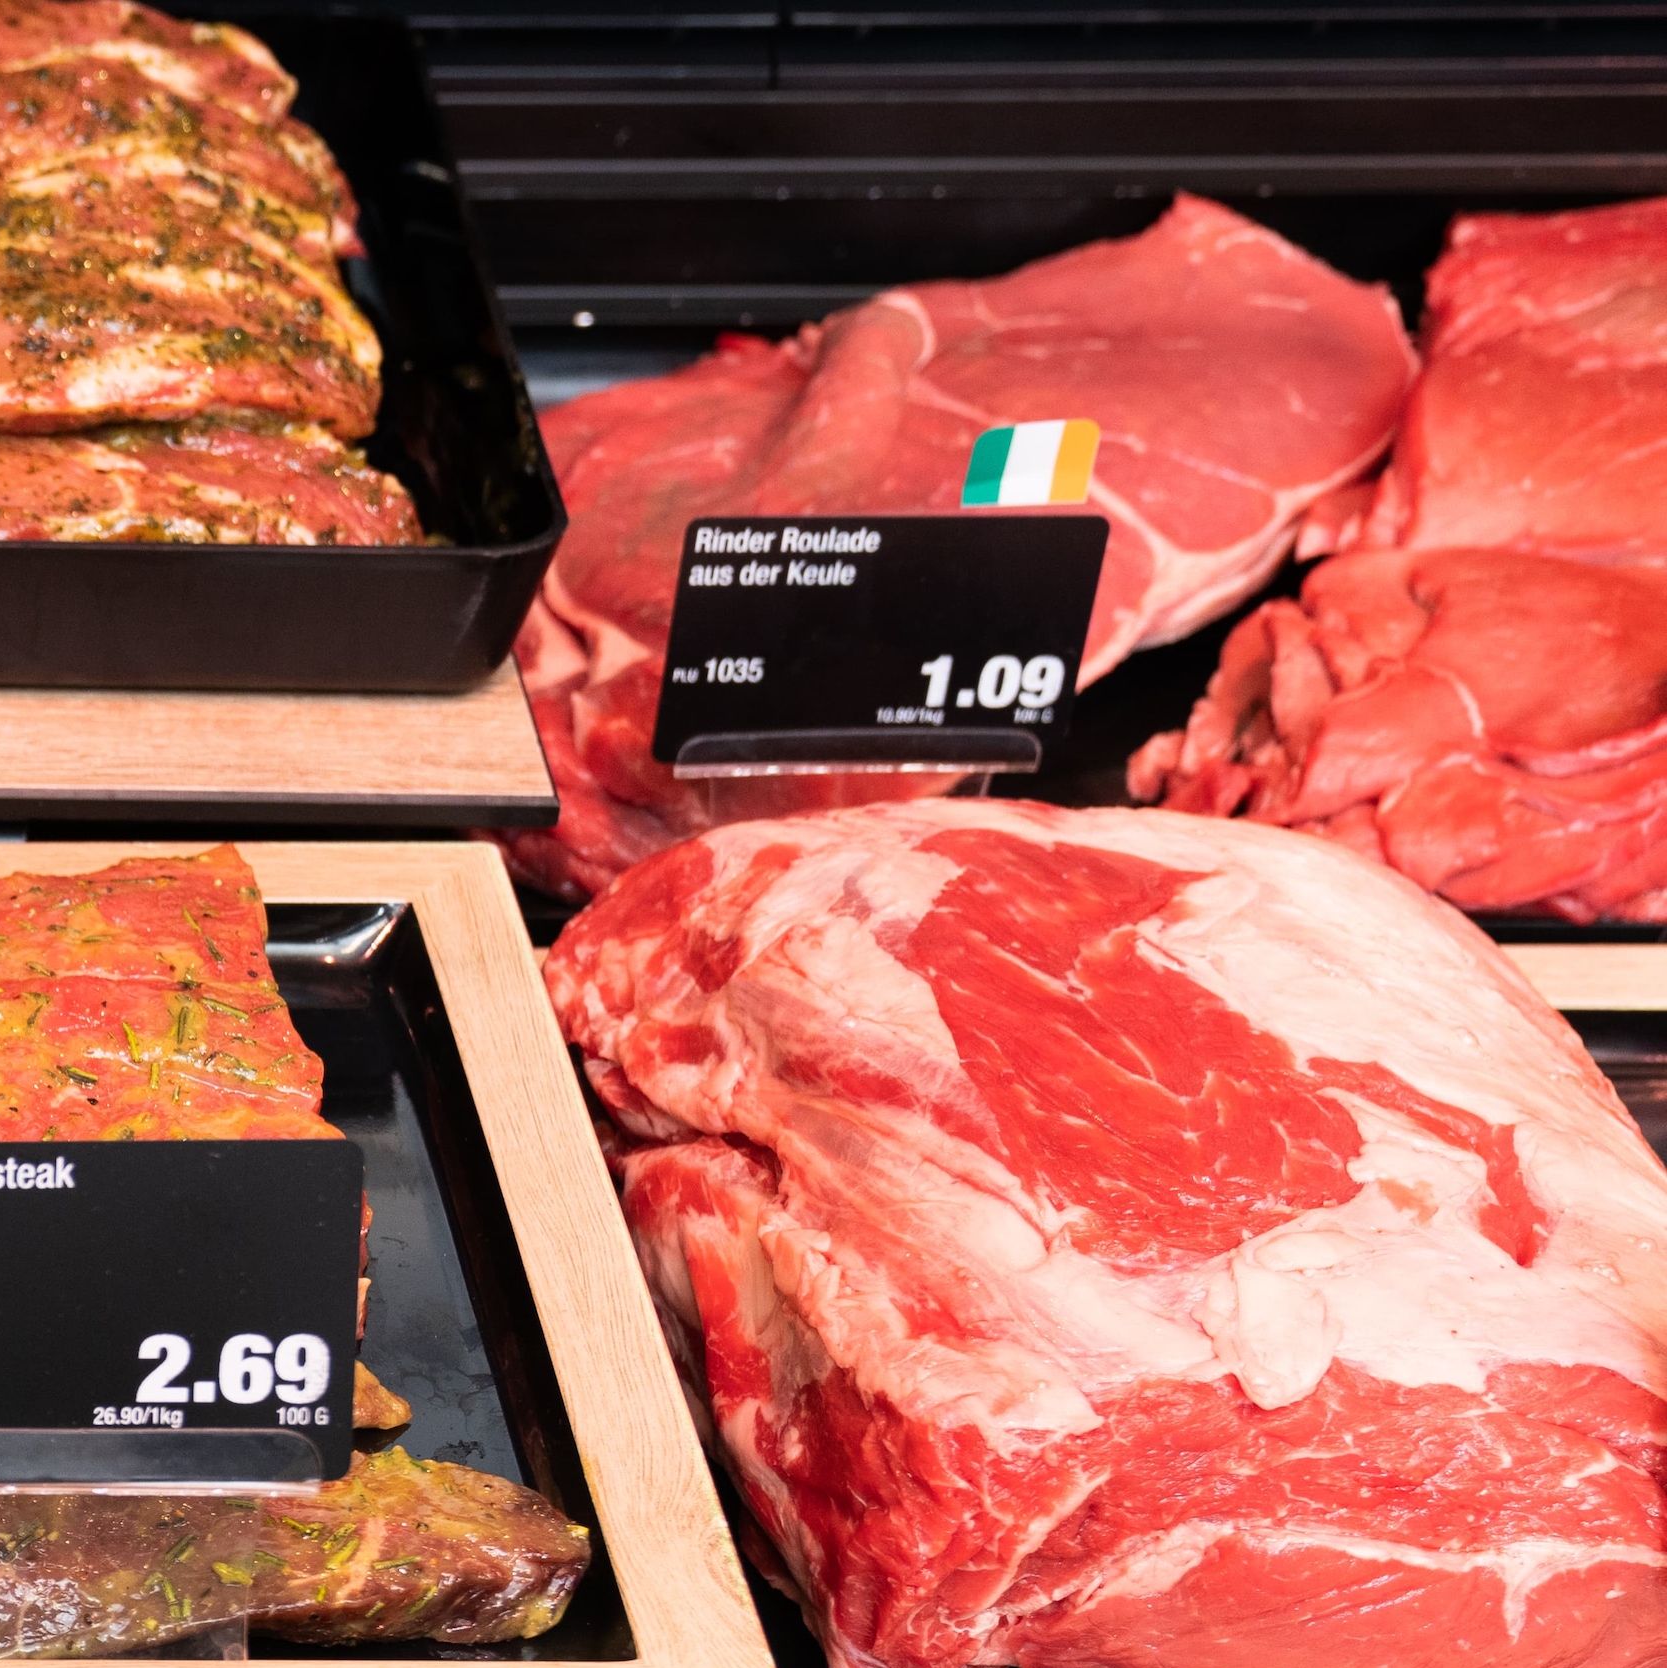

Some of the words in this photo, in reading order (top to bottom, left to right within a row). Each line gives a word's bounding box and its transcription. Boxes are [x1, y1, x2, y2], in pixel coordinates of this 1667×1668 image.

[694, 526, 776, 553] Rinder
[780, 527, 881, 553] Roulade
[689, 565, 734, 586] aus
[739, 561, 780, 586] der
[787, 560, 856, 586] Keule
[705, 658, 763, 683] 1035
[922, 656, 1064, 708] 1.09
[136, 1334, 329, 1404] 2.69
[92, 1407, 184, 1428] 26.90/1kg
[276, 1407, 309, 1425] 100
[315, 1407, 329, 1425] G
